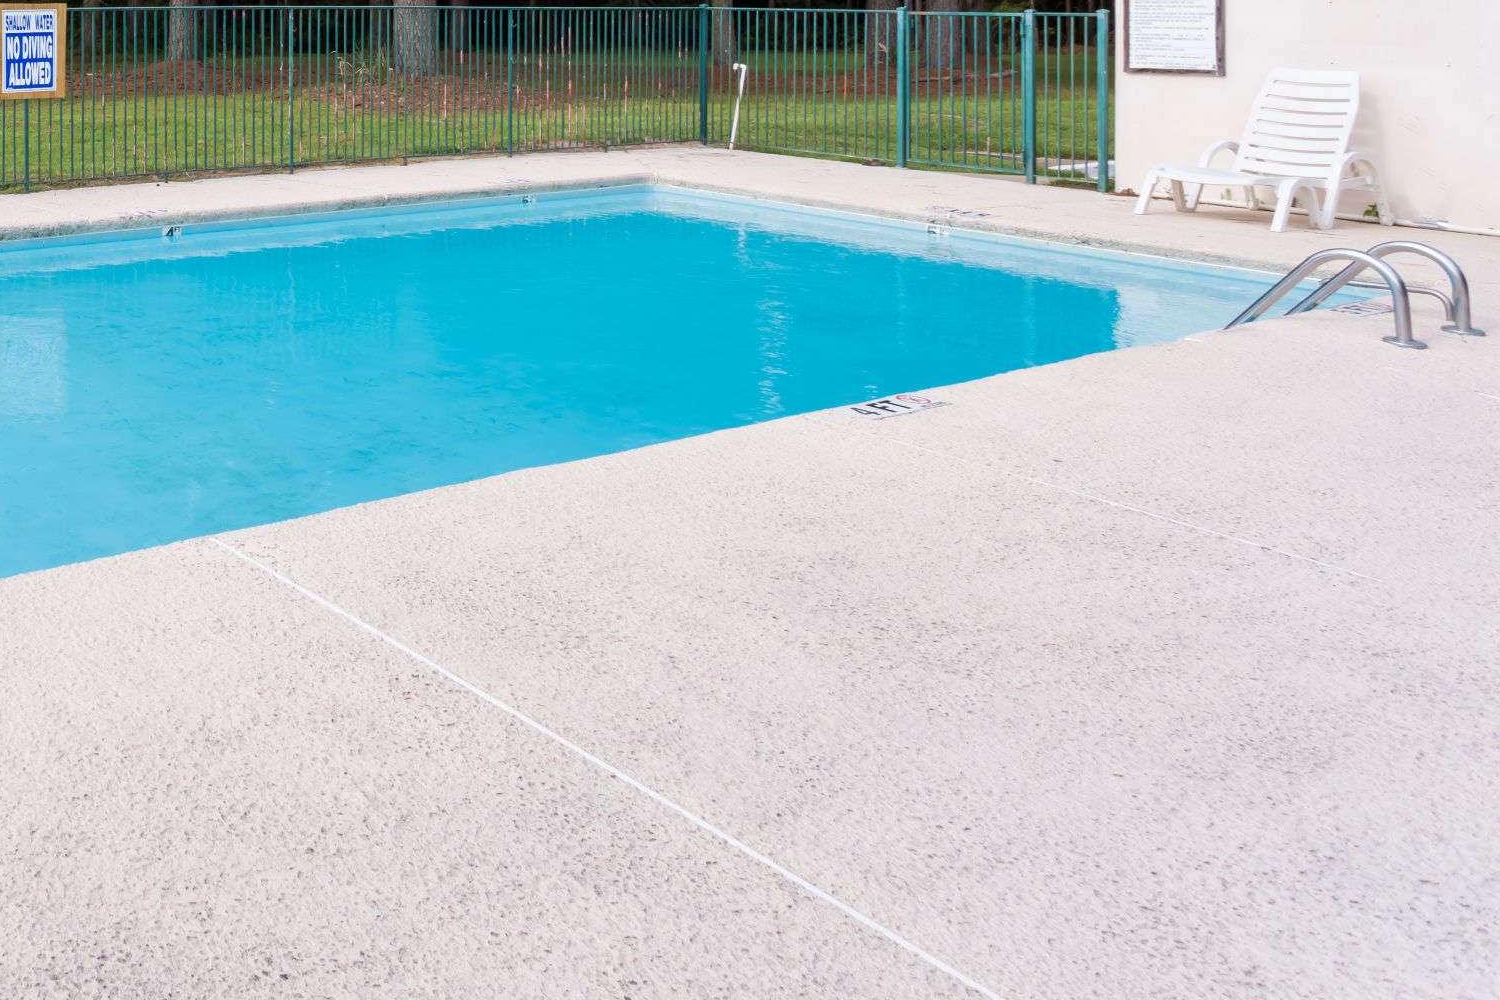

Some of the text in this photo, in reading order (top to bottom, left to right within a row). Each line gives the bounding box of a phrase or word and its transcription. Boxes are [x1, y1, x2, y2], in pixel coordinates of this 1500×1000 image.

[5, 14, 53, 31] SHALLOW WATER
[6, 35, 53, 60] NO DIVING
[9, 61, 51, 86] ALLOWED
